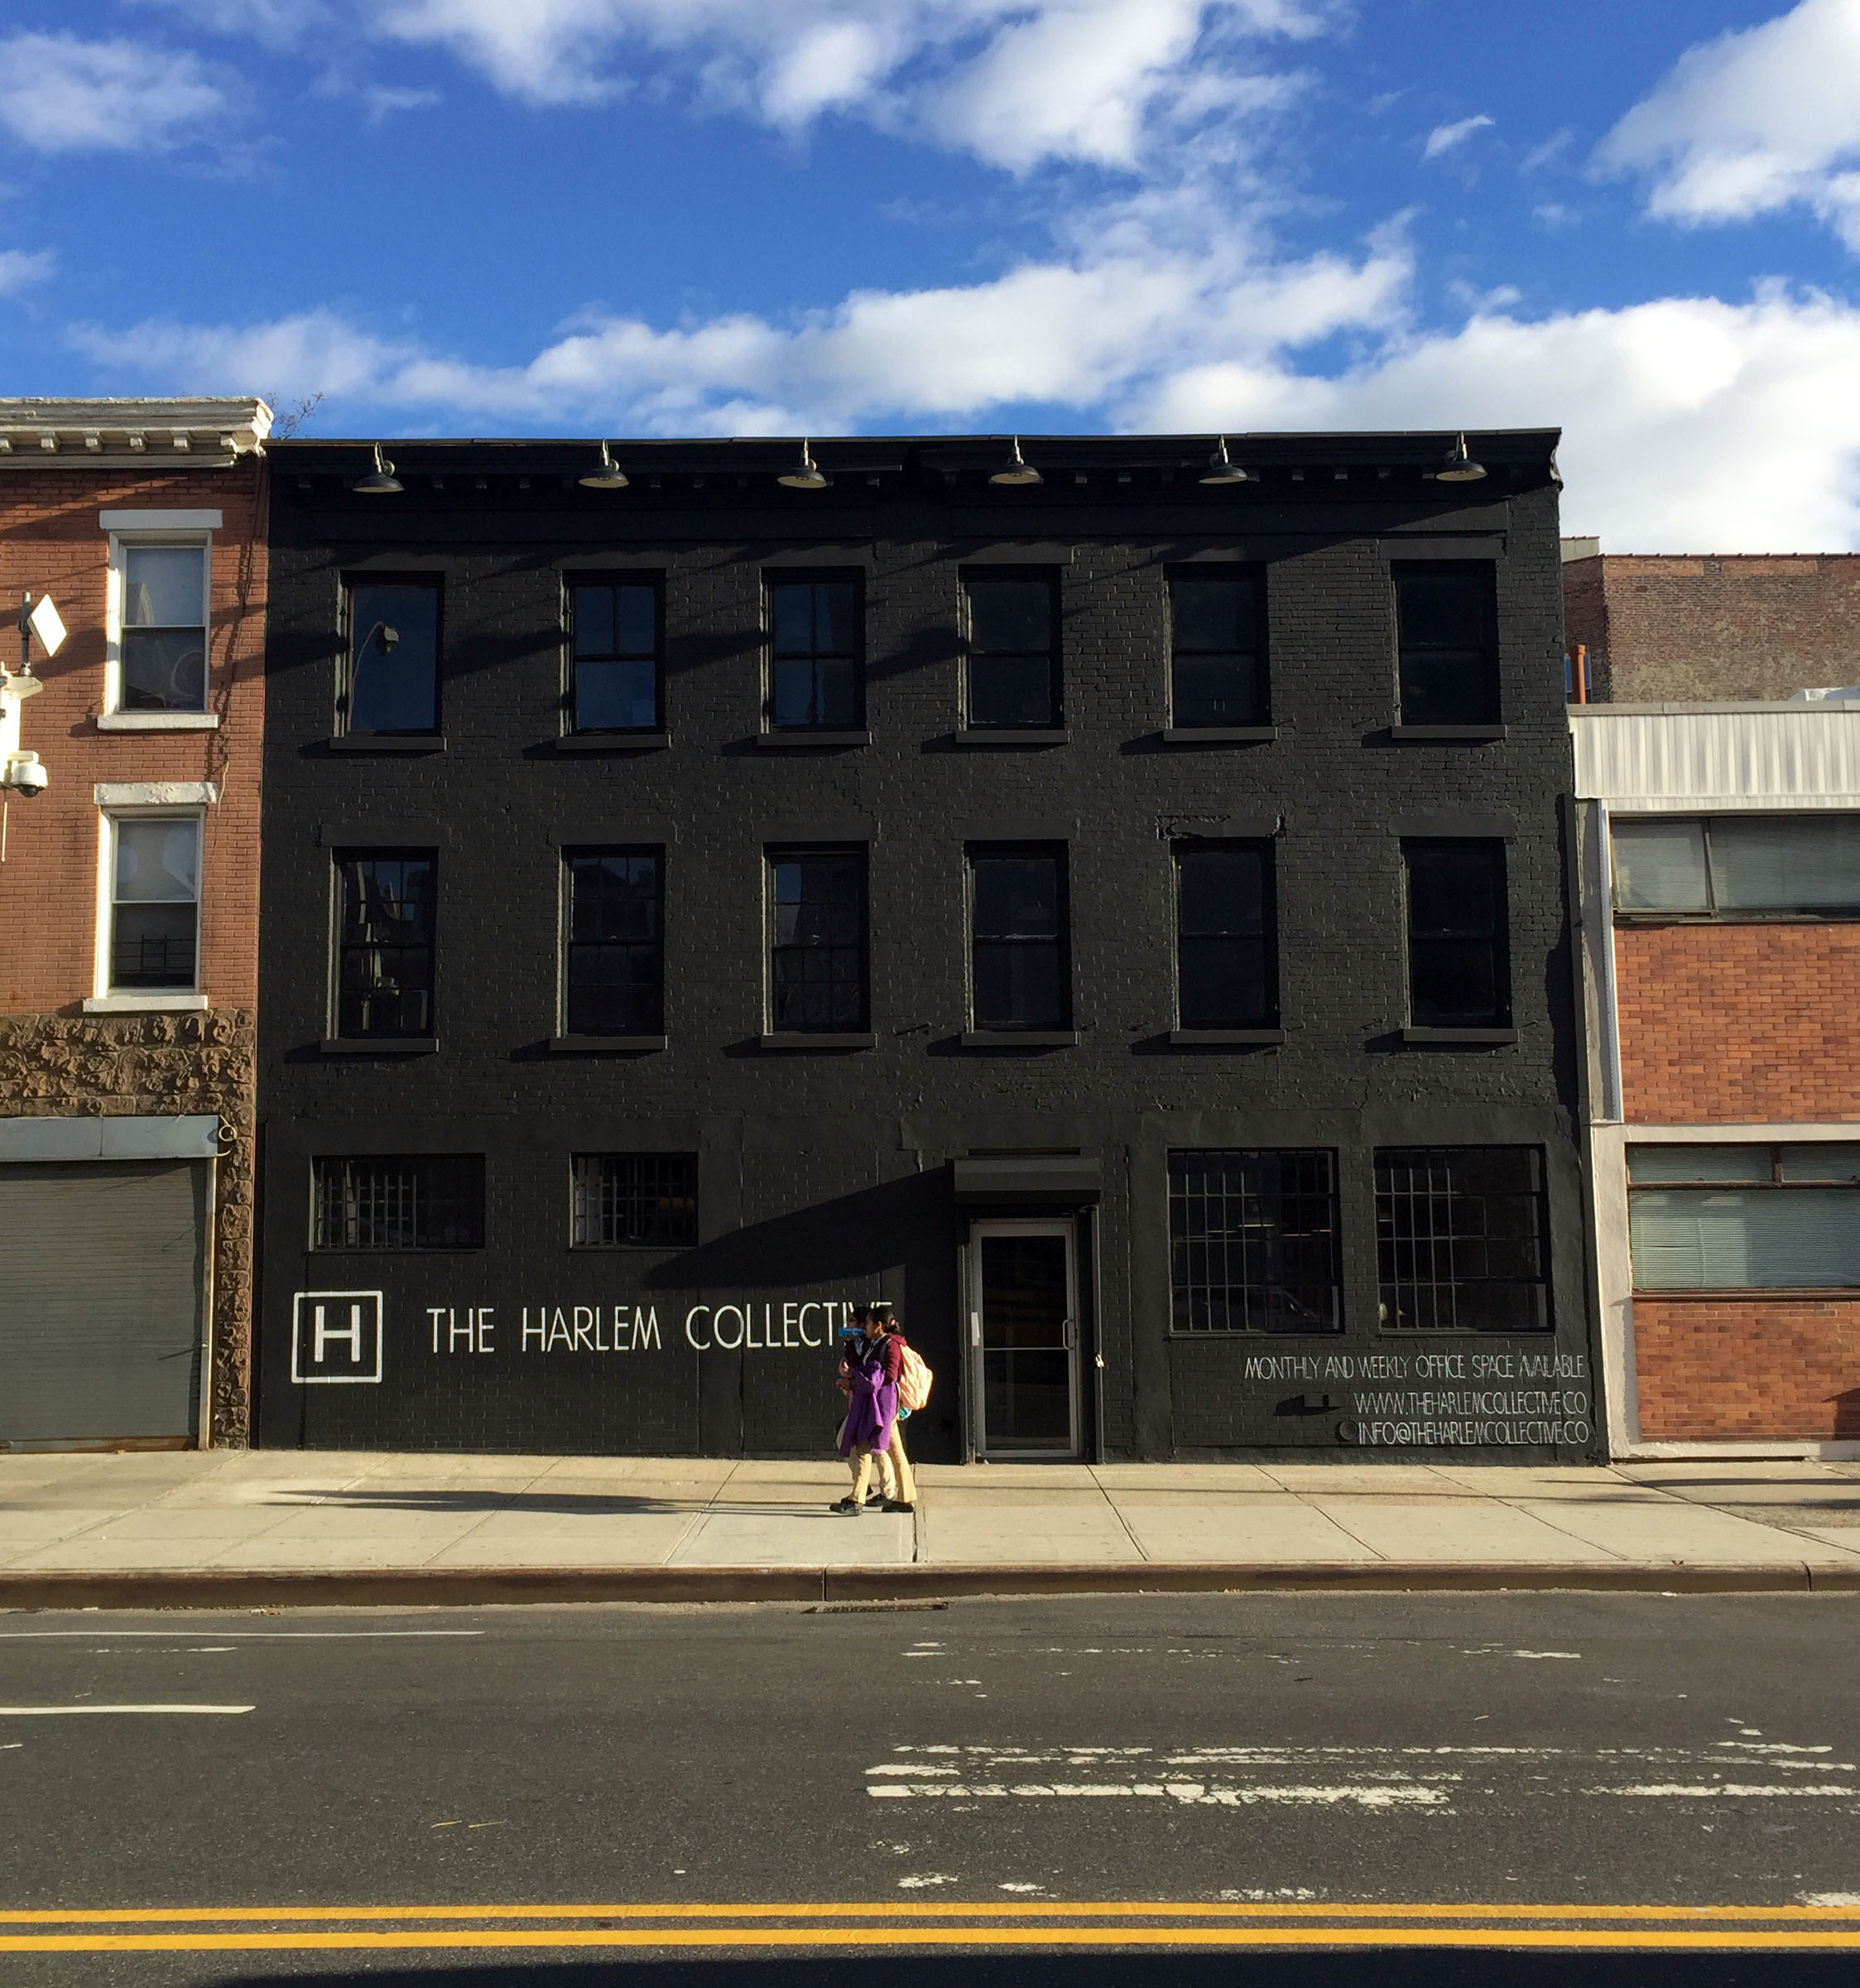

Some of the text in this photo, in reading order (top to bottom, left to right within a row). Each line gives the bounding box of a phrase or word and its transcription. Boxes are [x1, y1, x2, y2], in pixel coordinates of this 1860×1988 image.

[314, 1305, 360, 1363] H
[426, 1301, 892, 1354] THE HARLEM COLLECTI
[1244, 1354, 1585, 1379] MONTHLY AND WEEKLY OFFICE SPACE AVAILABLE
[1358, 1420, 1589, 1445] INFO@THEHARLEMCOLLECTIVE.CO
